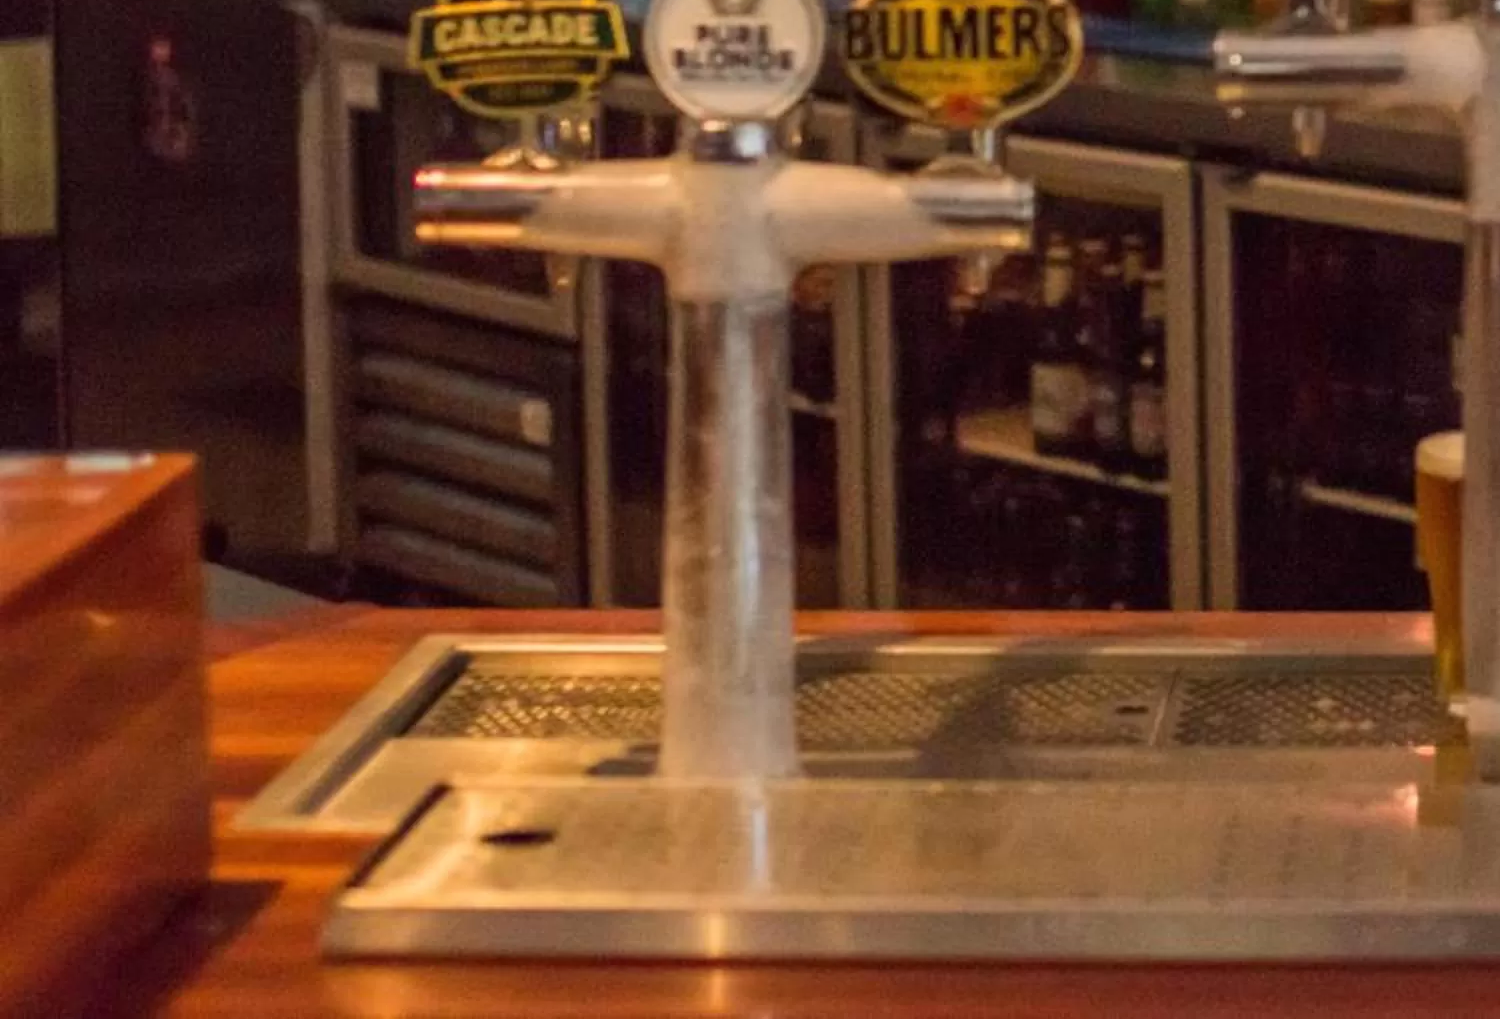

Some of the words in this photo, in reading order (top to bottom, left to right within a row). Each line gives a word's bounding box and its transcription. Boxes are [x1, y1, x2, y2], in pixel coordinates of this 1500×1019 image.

[433, 12, 600, 53] CASCADE
[846, 4, 1069, 62] BULMERS
[673, 47, 793, 73] BLONDE
